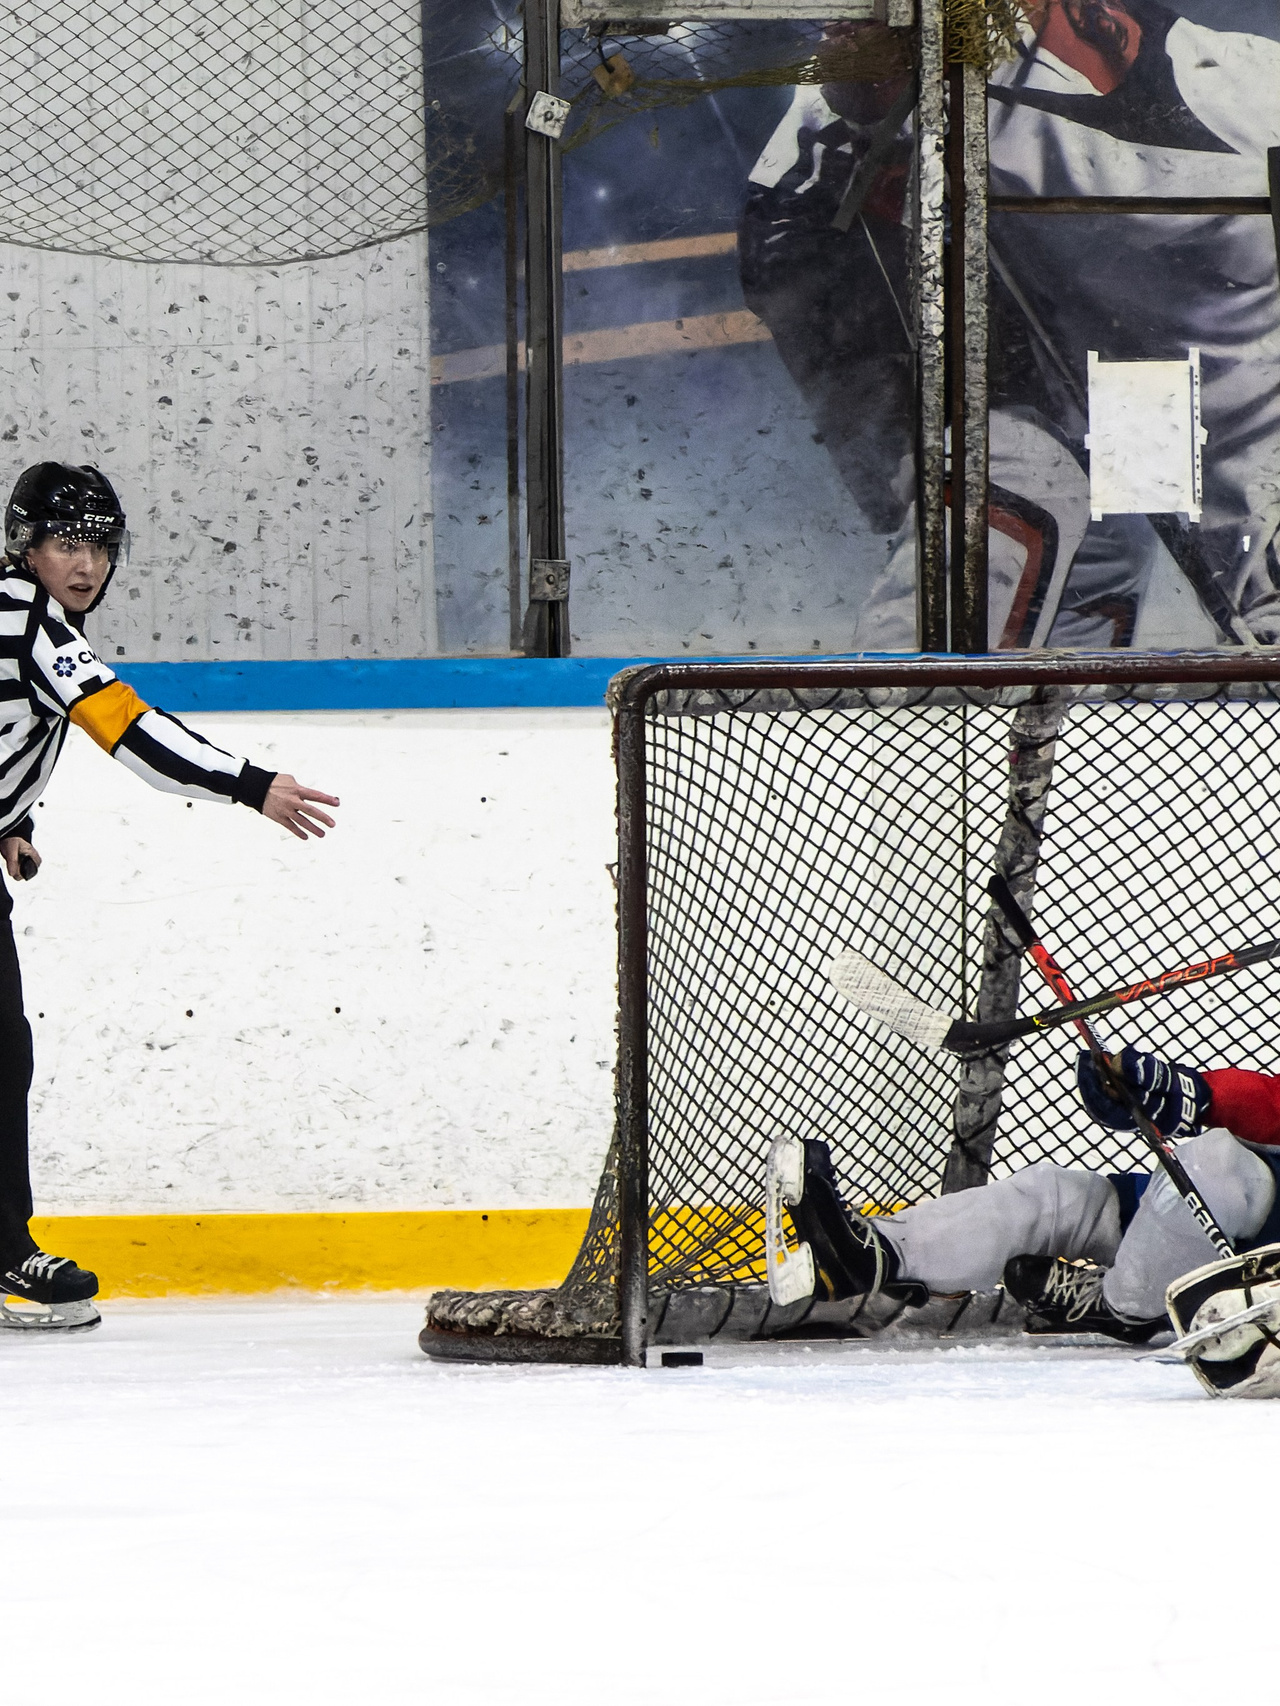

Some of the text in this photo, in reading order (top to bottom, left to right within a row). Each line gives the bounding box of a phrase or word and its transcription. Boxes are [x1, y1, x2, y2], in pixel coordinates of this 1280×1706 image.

[12, 503, 28, 516] CCM
[83, 513, 115, 523] CCM
[1116, 953, 1240, 1002] VAPOR
